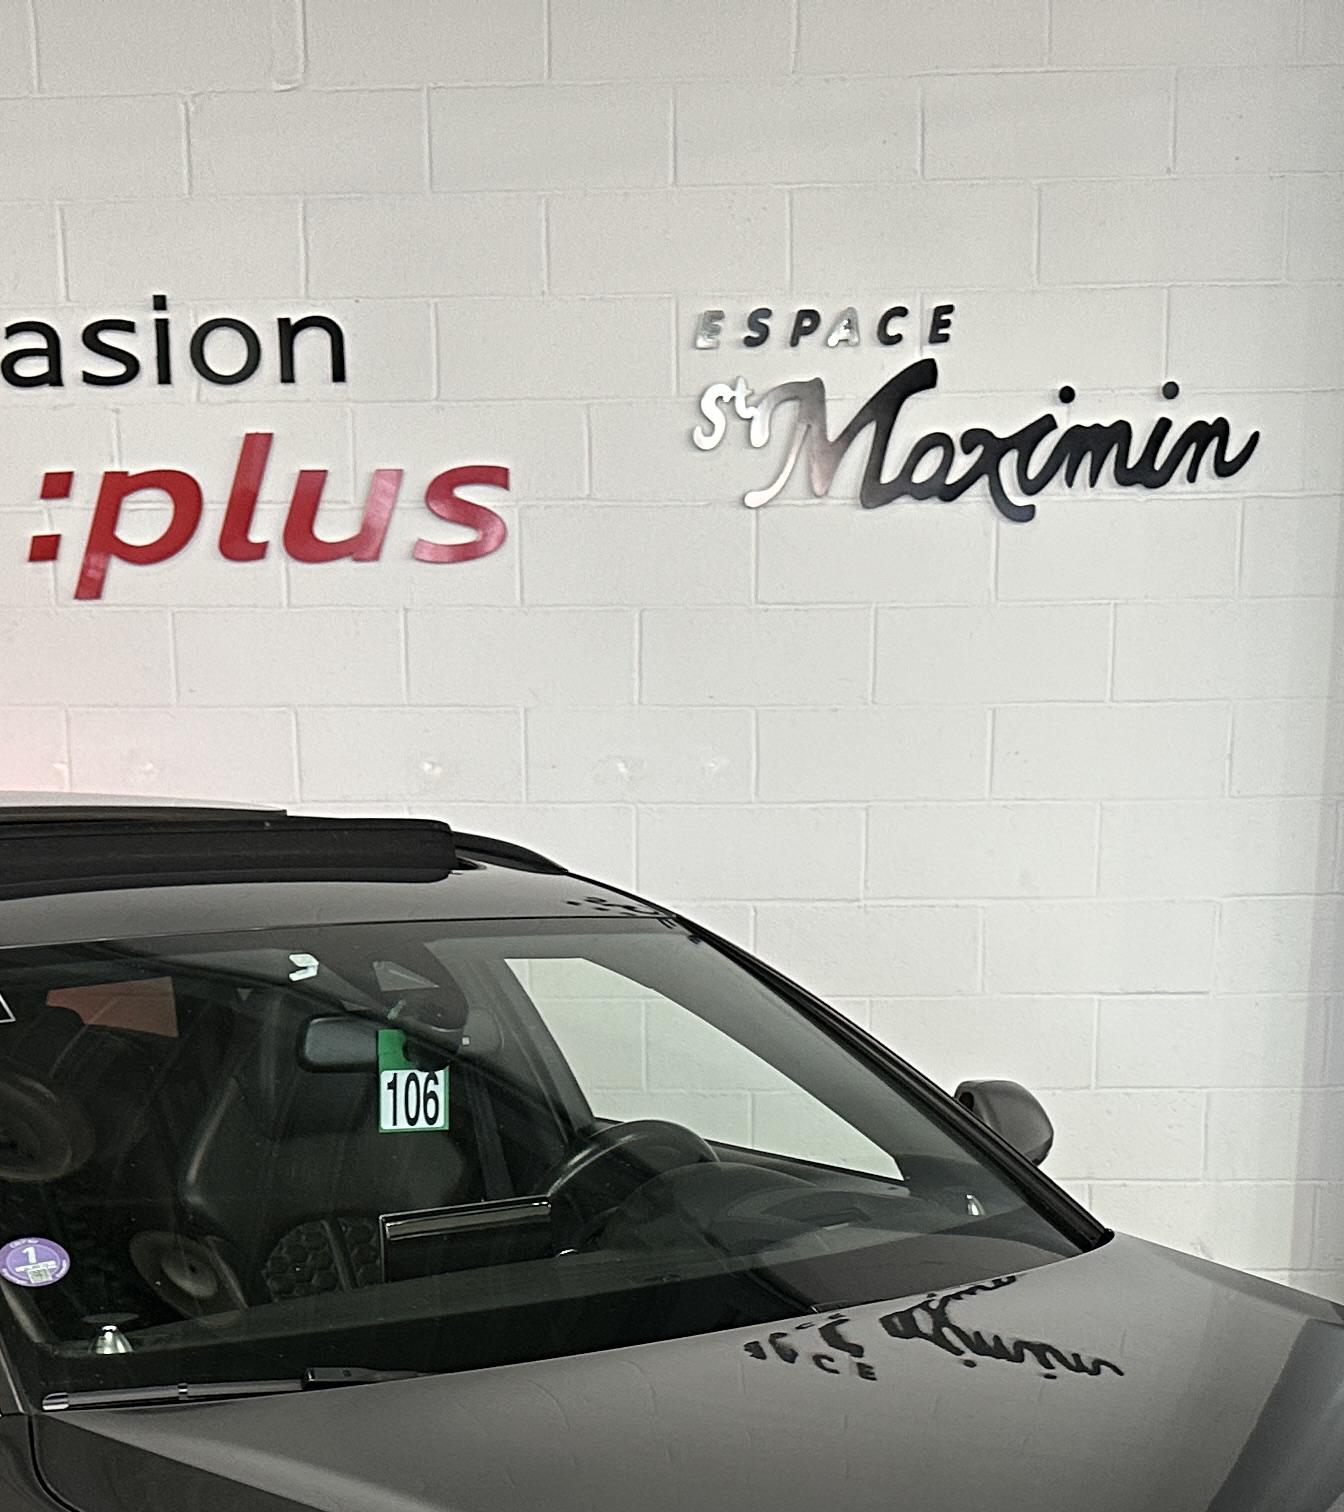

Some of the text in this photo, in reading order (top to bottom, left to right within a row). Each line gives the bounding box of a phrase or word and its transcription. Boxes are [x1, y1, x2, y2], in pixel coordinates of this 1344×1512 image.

[694, 304, 955, 350] ESPACE
[744, 358, 1260, 523] Maximin
[27, 432, 510, 601] :plus
[387, 1072, 439, 1127] 106
[22, 1246, 37, 1264] 1
